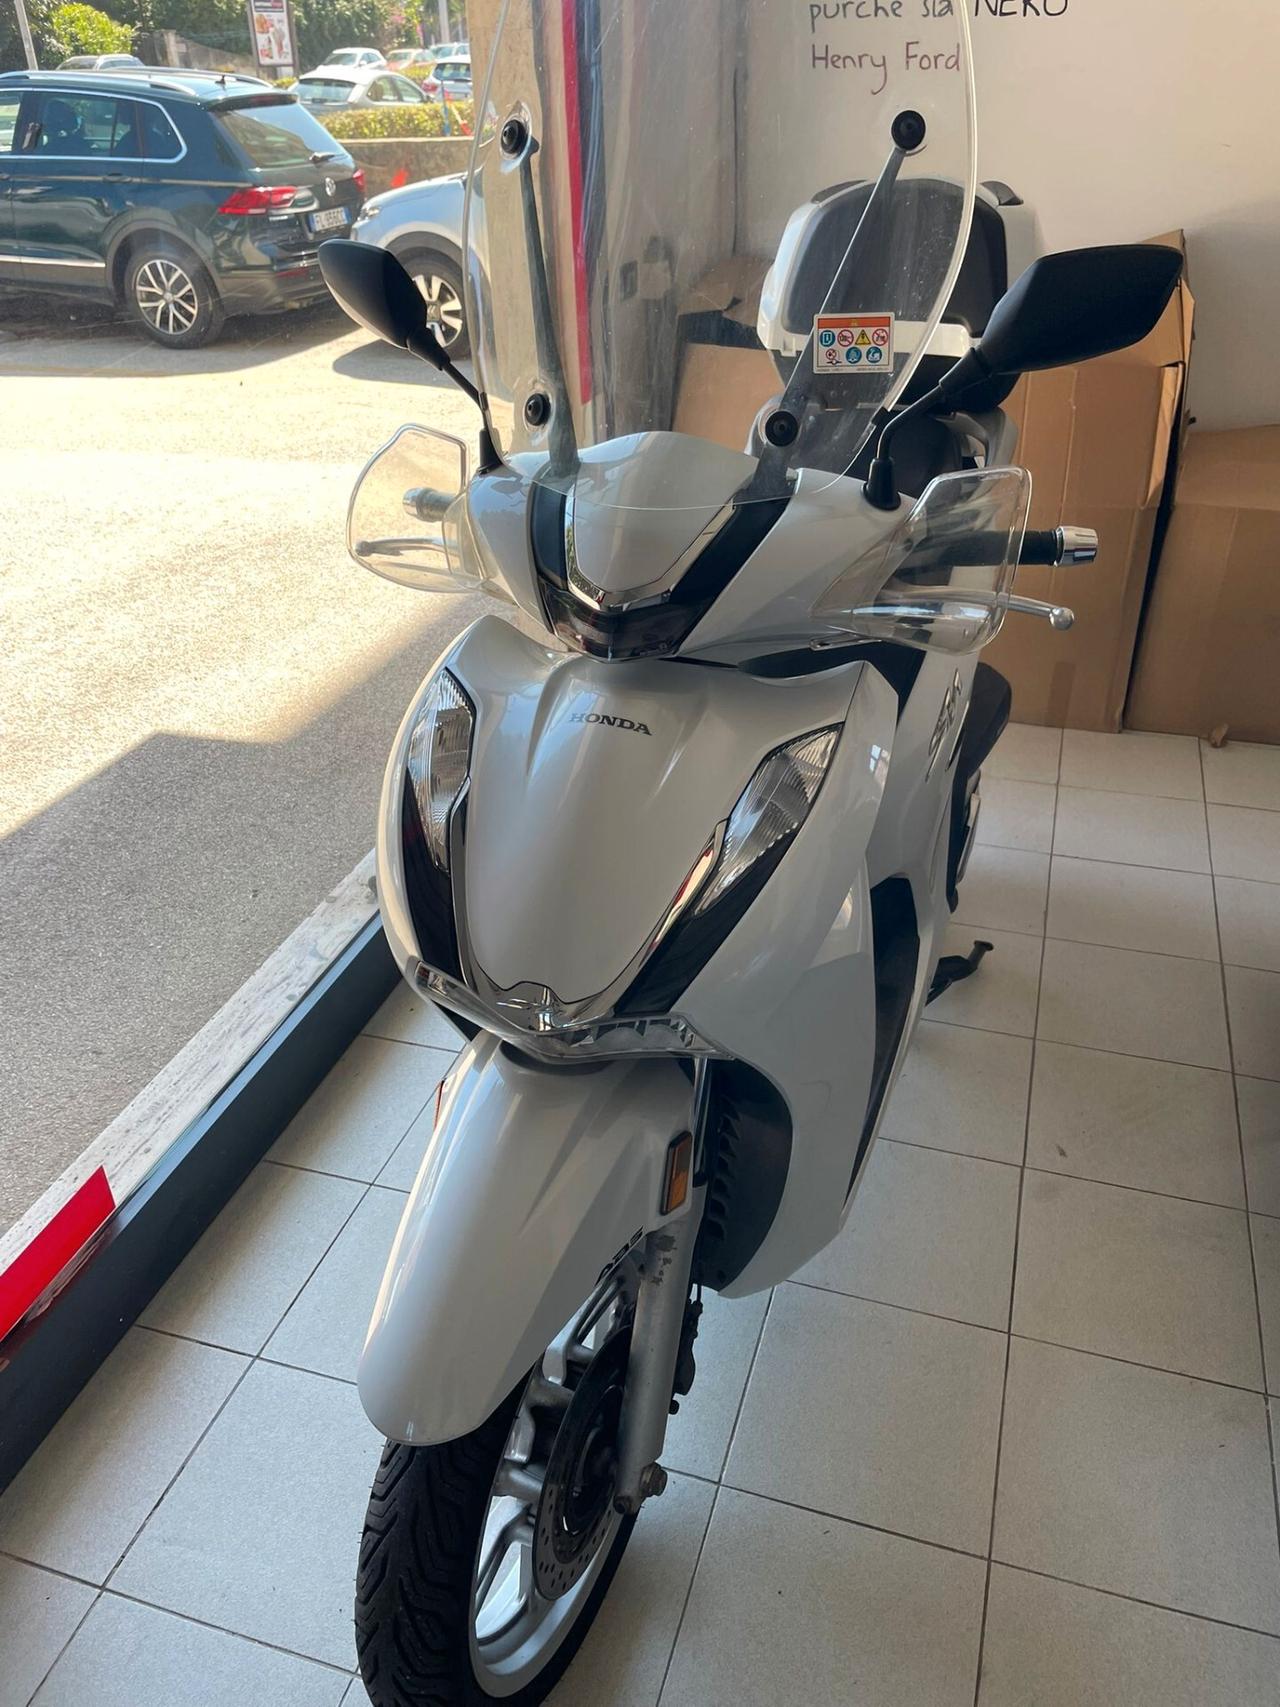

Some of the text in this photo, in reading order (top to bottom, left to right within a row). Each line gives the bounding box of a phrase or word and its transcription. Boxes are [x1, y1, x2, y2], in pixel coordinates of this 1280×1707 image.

[811, 40, 961, 96] Henry Ford
[569, 712, 652, 736] HONDA
